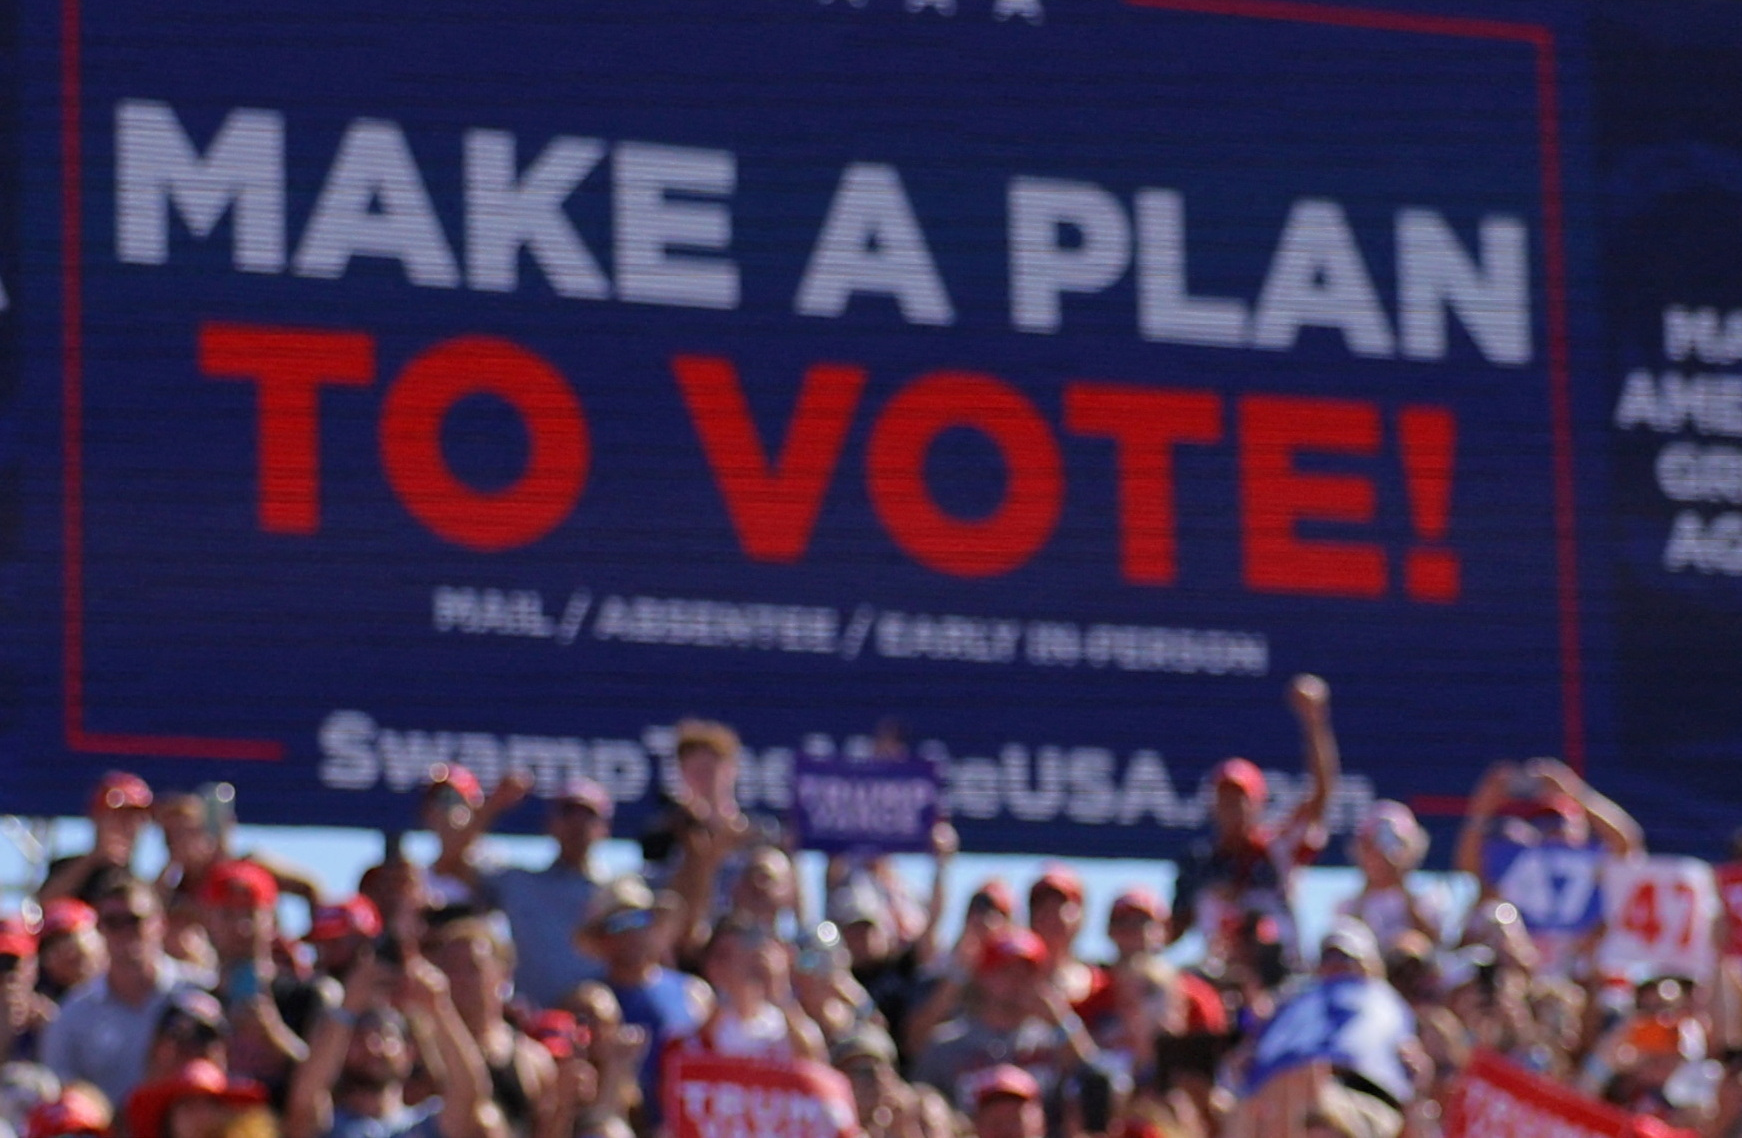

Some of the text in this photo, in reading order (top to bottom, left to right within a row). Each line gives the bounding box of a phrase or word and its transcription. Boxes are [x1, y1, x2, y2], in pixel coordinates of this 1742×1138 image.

[115, 98, 1532, 366] MAKE A PLAN
[198, 320, 1462, 604] TO VOTE!
[432, 585, 554, 638] MAIL
[876, 610, 1021, 663] EARLY
[1500, 846, 1598, 928] 47
[1619, 878, 1696, 950] 47
